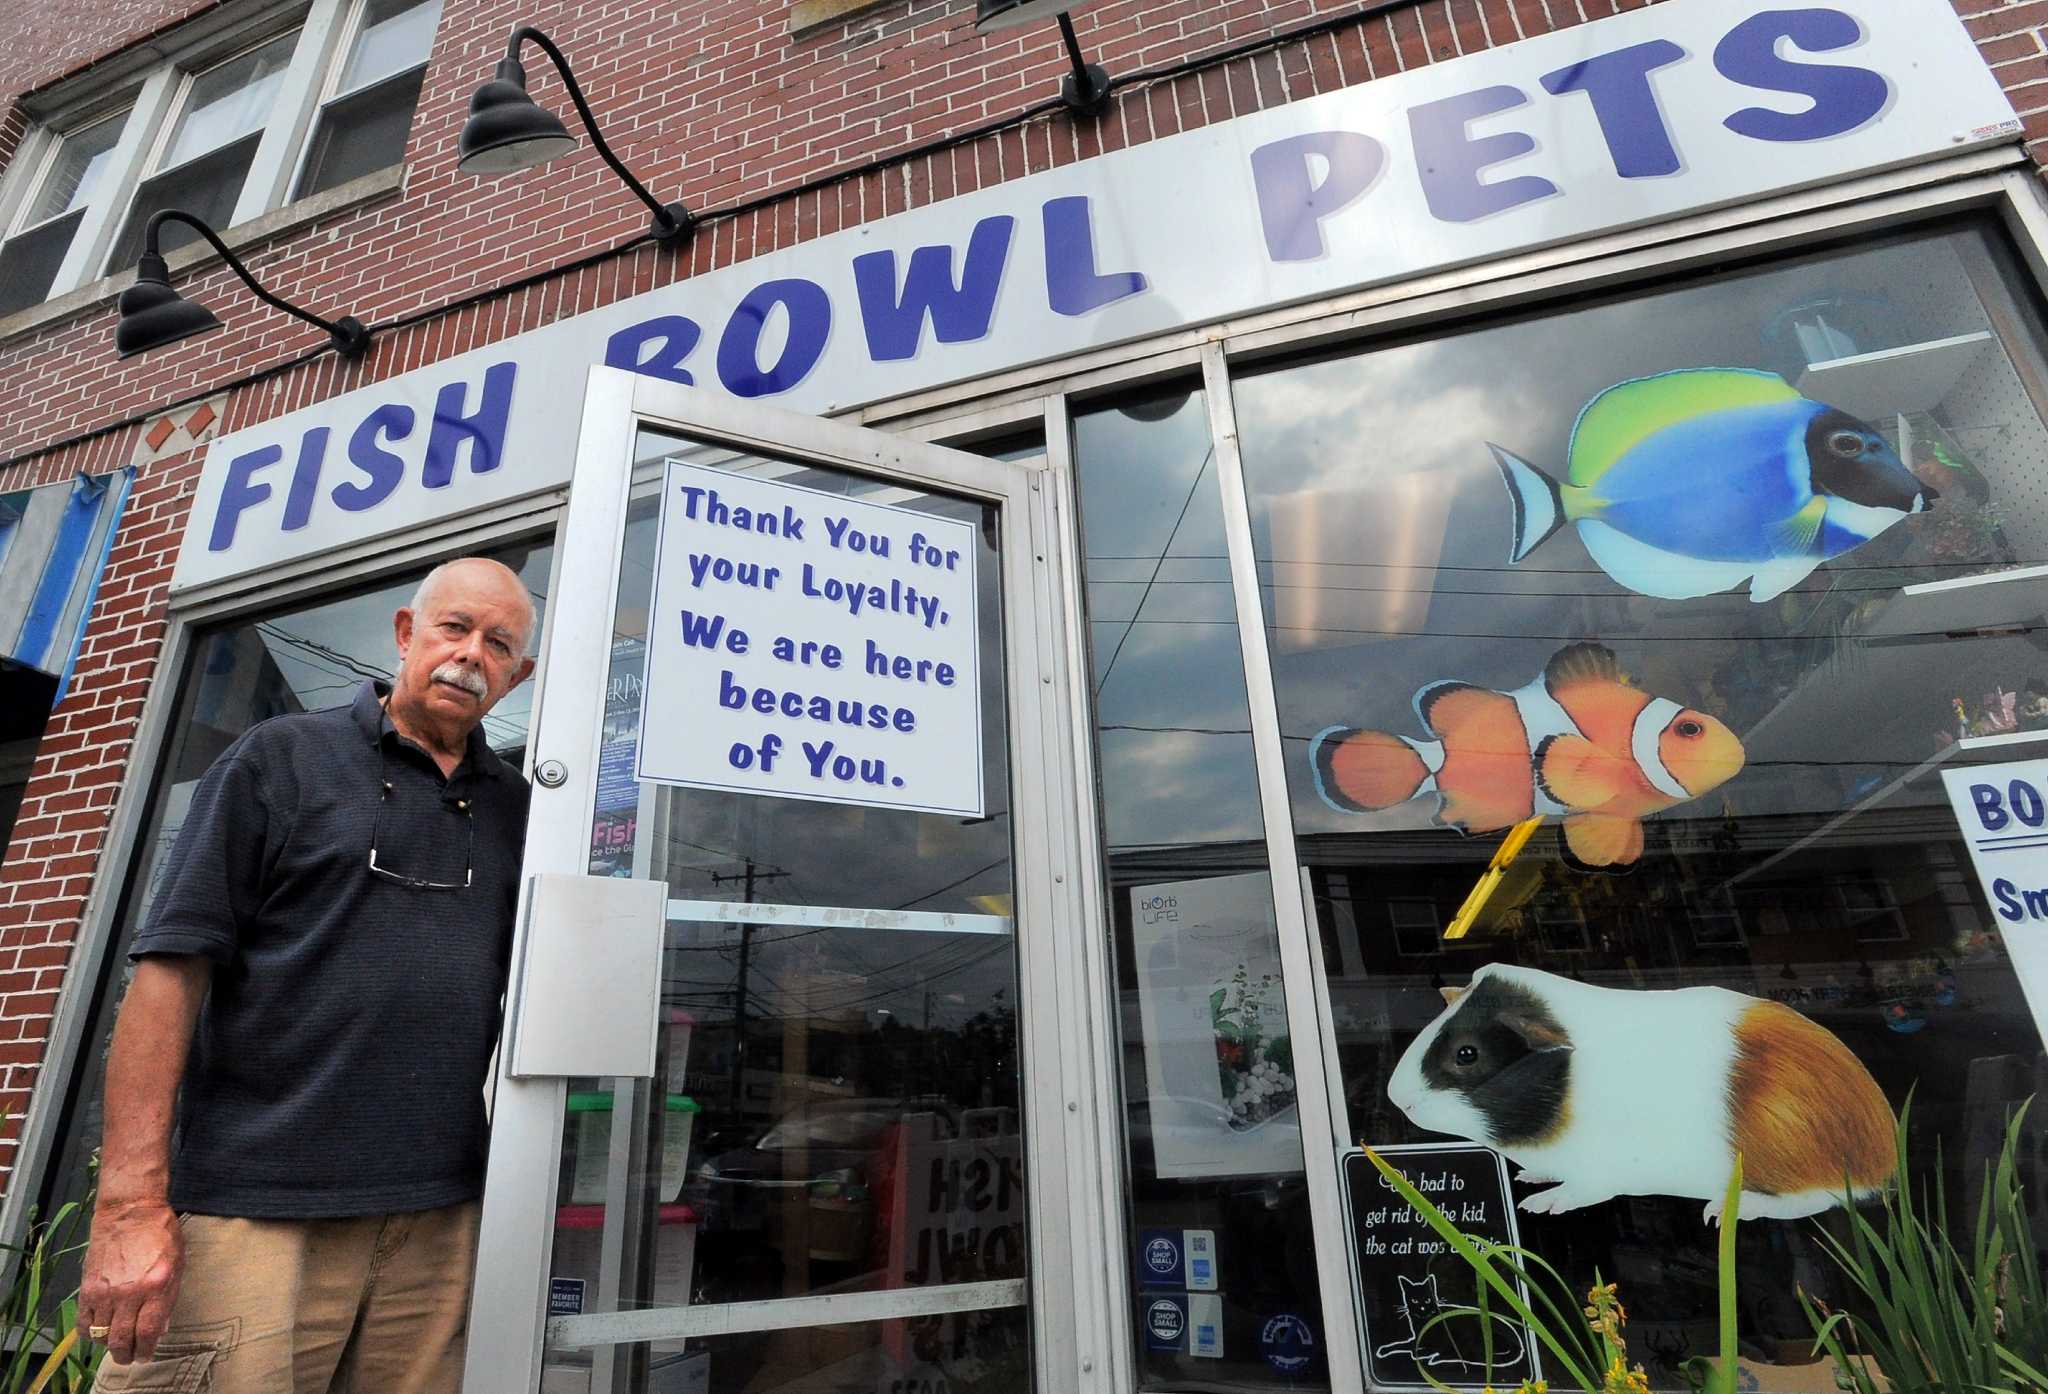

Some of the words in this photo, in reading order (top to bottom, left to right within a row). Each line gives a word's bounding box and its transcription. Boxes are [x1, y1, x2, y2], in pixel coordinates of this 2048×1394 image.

[208, 361, 517, 551] FISH
[604, 195, 1149, 398] BOWL
[1249, 7, 1891, 263] PETS
[680, 485, 805, 541] Thank
[823, 516, 890, 558] You
[908, 532, 960, 571] for
[688, 553, 781, 590] your
[801, 563, 950, 629] Loyalty,
[680, 609, 751, 655] We
[771, 635, 843, 669] are
[865, 639, 956, 687] here
[719, 669, 917, 733] because
[728, 733, 783, 773] of
[801, 740, 906, 789] You.
[1969, 776, 2048, 832] BO
[1420, 1171, 1447, 1192] had
[1451, 1174, 1465, 1191] to
[1365, 1206, 1387, 1228] get
[1391, 1203, 1411, 1223] rid
[1461, 1201, 1487, 1223] kid,
[1366, 1234, 1387, 1255] the
[1391, 1237, 1413, 1255] cat
[1418, 1241, 1446, 1255] was
[1154, 1319, 1178, 1328] SMALL
[1155, 1312, 1177, 1320] SHOP
